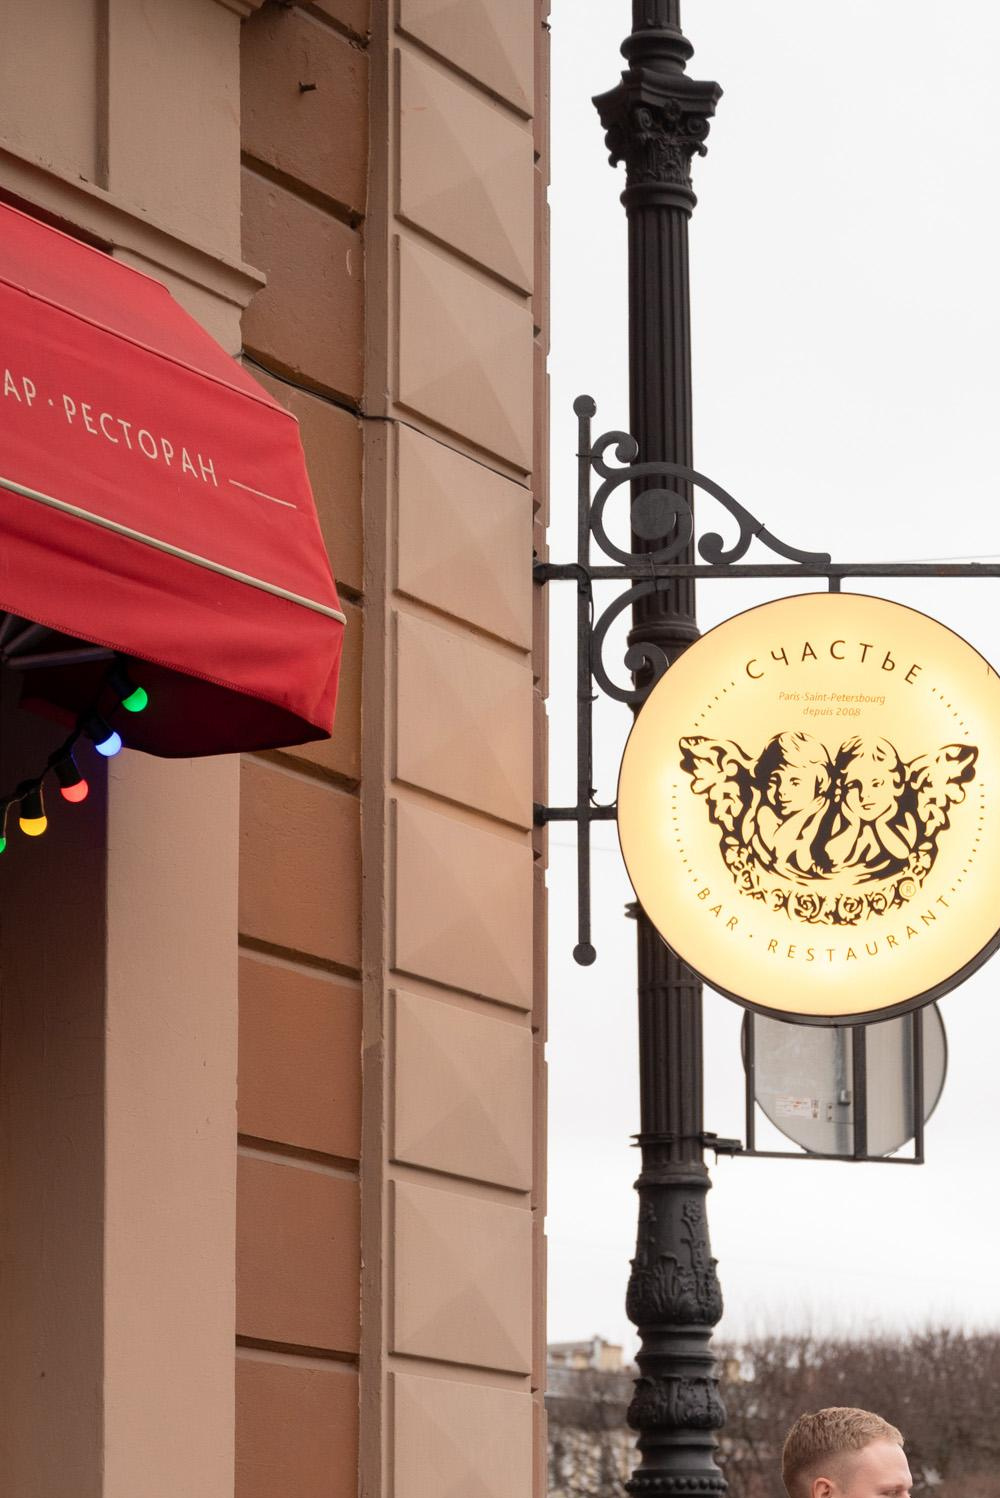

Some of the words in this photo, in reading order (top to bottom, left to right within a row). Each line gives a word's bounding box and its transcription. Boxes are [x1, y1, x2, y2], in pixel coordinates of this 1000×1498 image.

[62, 393, 219, 488] РЕСТОРАН
[745, 639, 923, 686] СЧАСТЬЕ
[802, 706, 833, 718] depuis
[836, 707, 861, 717] 2008
[697, 886, 739, 933] BAR
[767, 894, 951, 963] RESTAURANT
